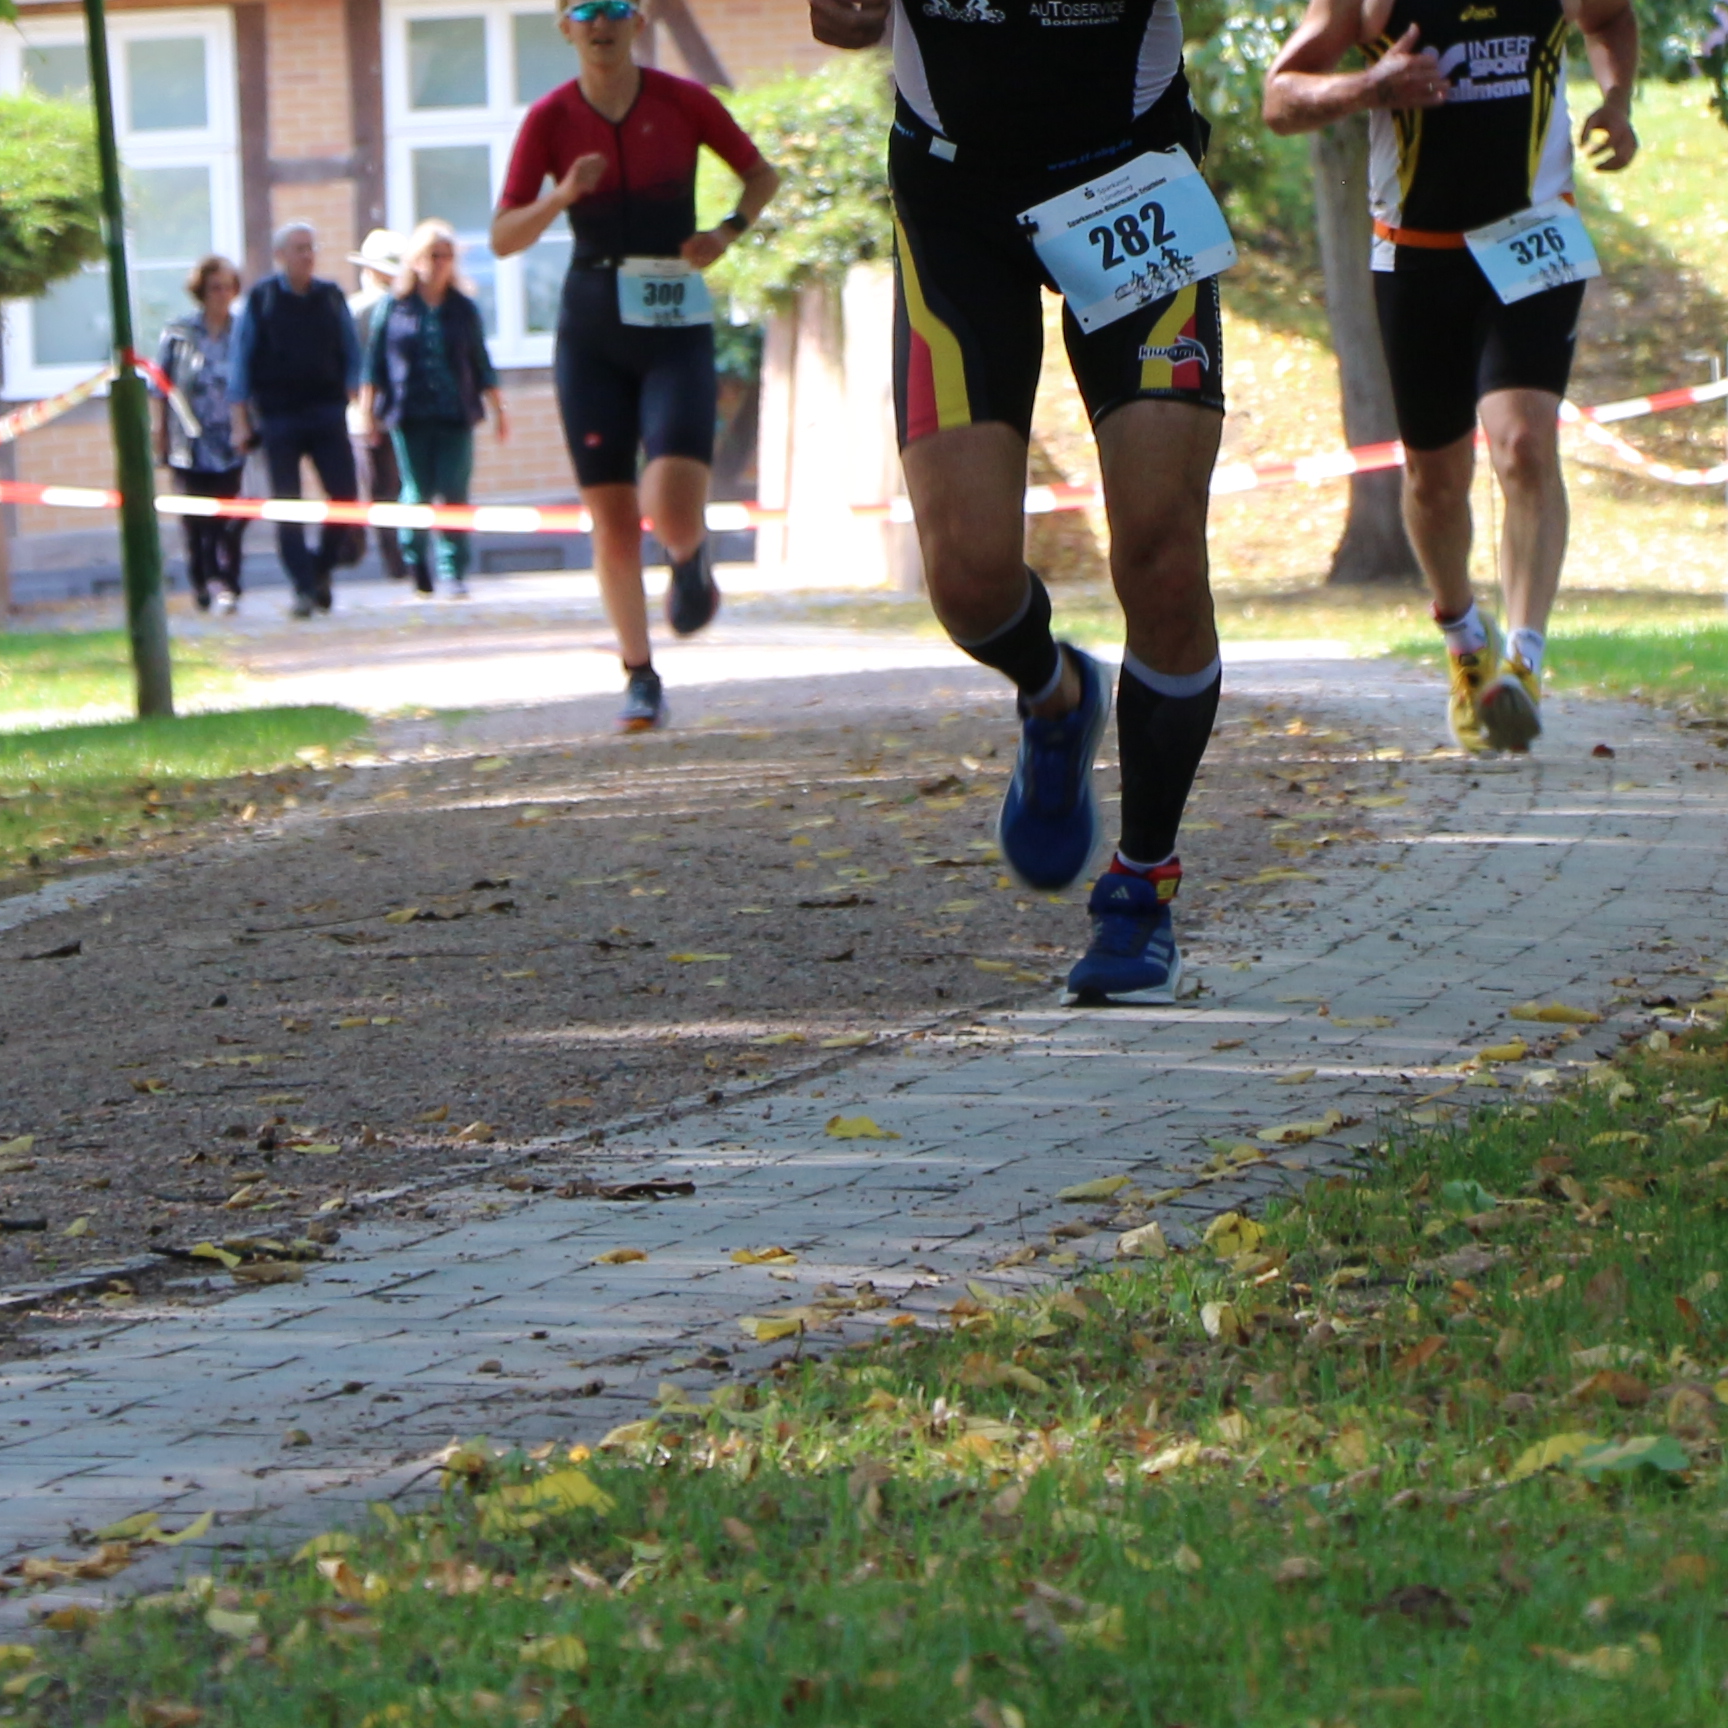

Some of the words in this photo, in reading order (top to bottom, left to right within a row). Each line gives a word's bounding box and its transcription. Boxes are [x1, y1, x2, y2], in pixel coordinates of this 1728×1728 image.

[1029, 0, 1126, 18] AUTOSERVICE
[1040, 15, 1120, 27] Bodenteich
[1469, 35, 1532, 61] INTER
[1469, 55, 1530, 78] SPORT
[1088, 201, 1177, 271] 282
[1509, 225, 1566, 266] 326
[642, 282, 686, 307] 300
